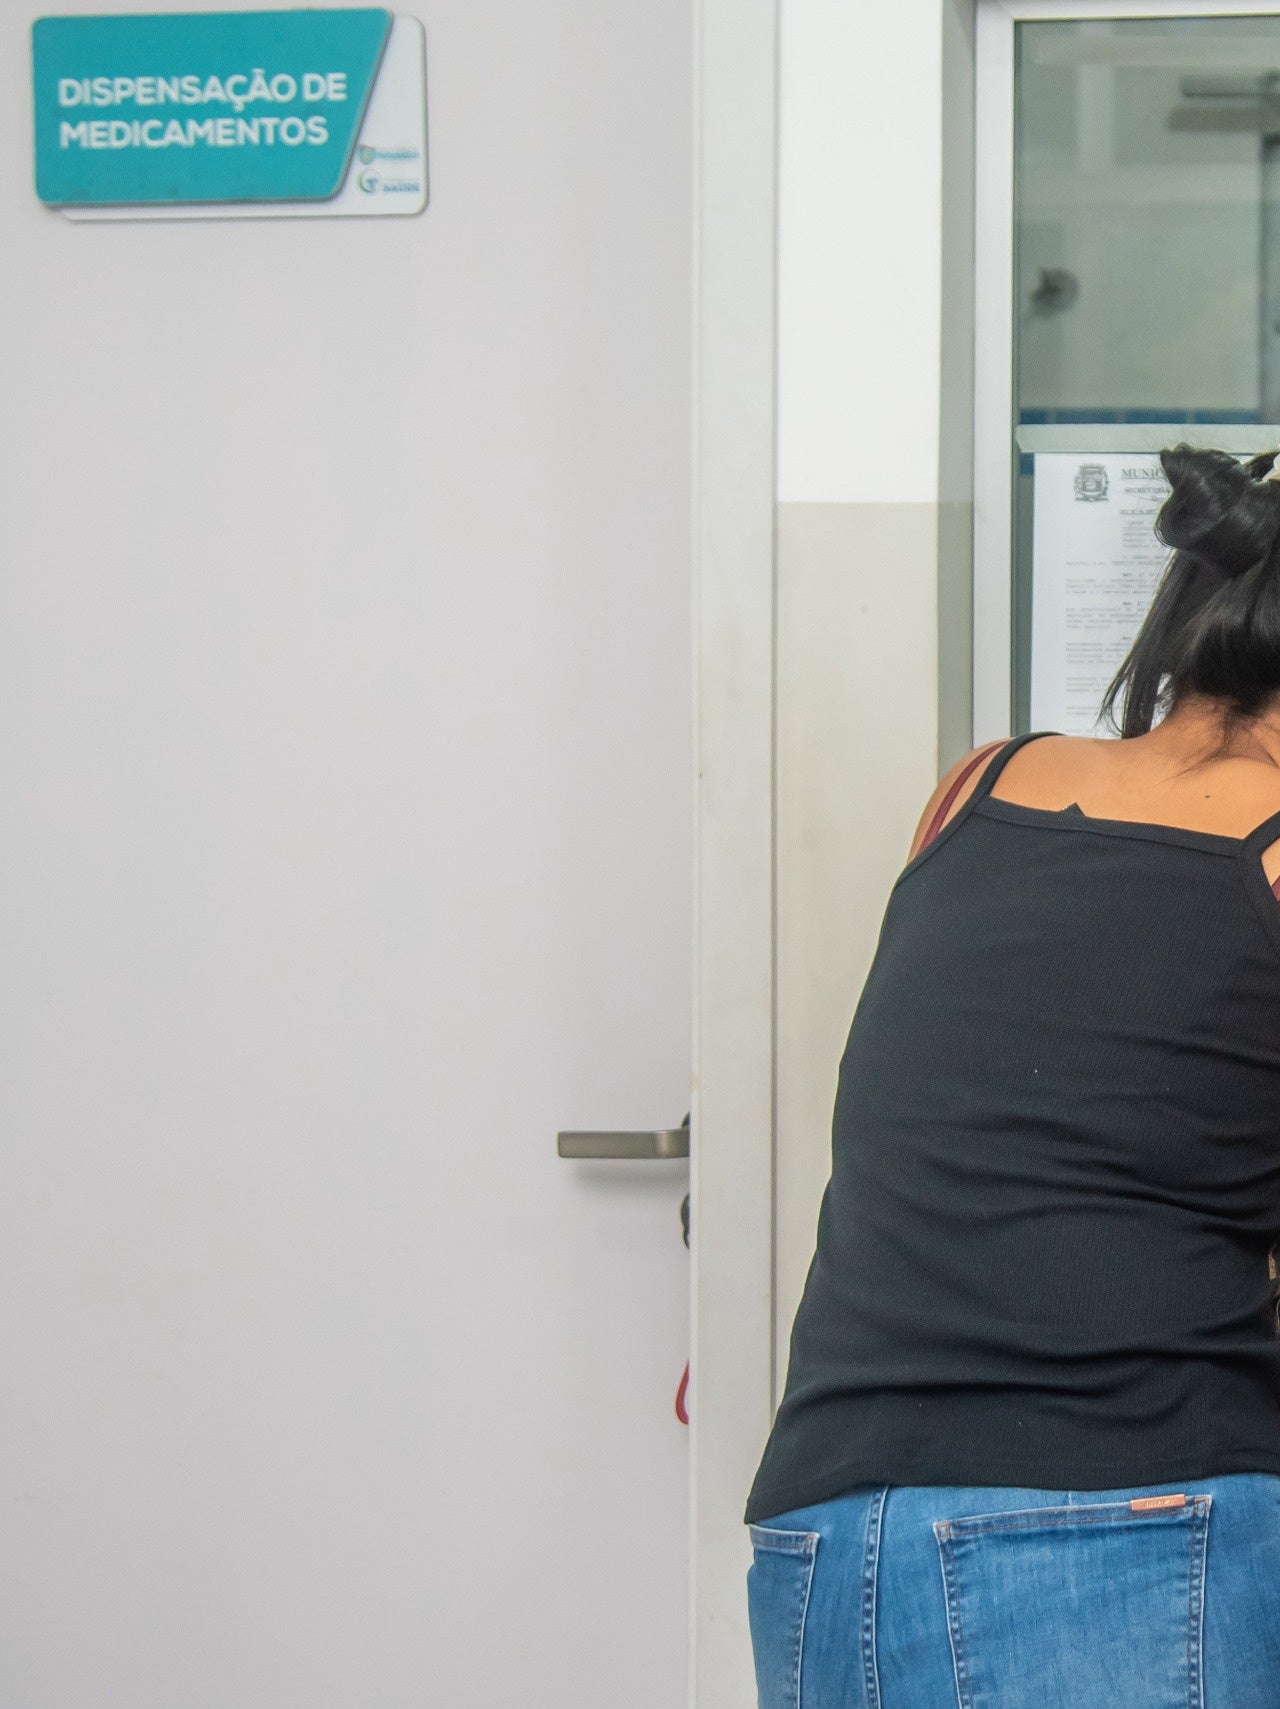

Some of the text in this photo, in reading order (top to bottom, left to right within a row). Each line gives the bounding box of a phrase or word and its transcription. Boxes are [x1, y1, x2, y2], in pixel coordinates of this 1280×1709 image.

[58, 68, 348, 112] DISPENSAÇÃO DE
[59, 115, 329, 149] MEDICAMENTOS
